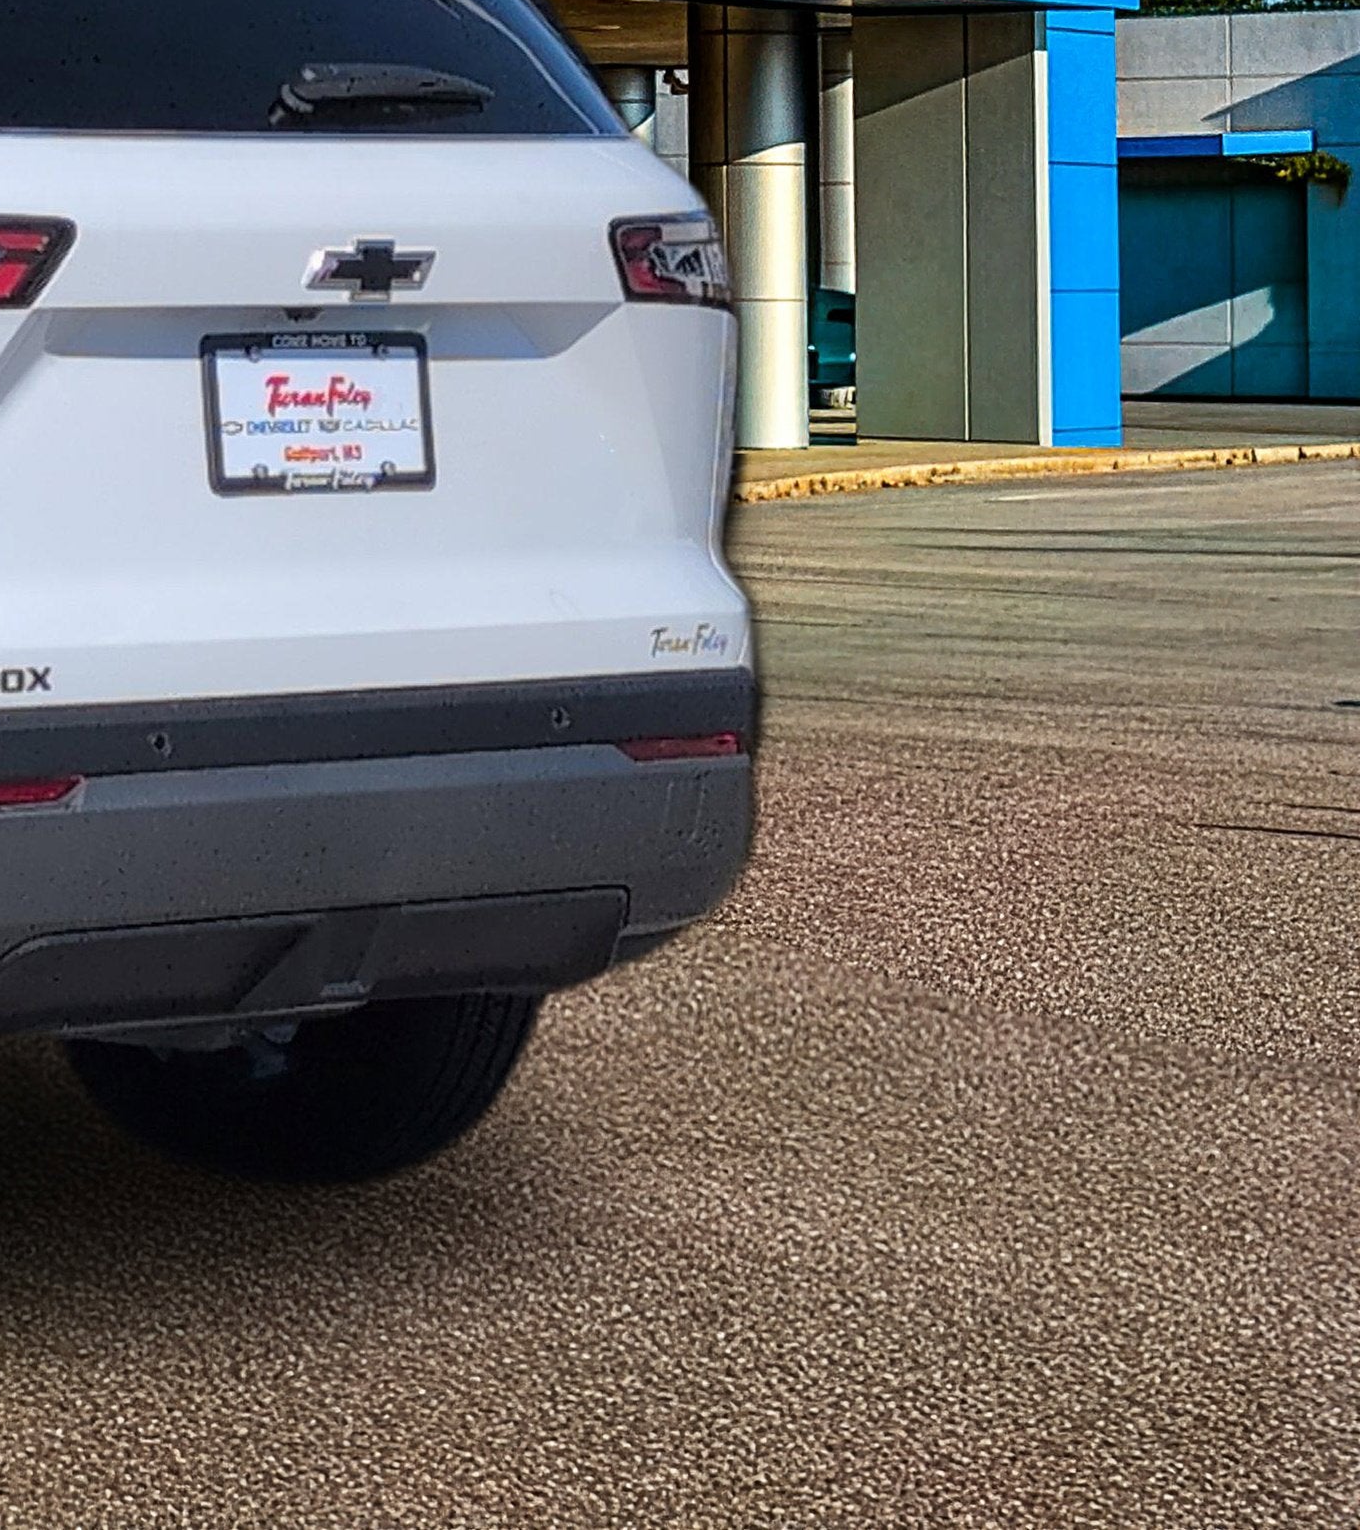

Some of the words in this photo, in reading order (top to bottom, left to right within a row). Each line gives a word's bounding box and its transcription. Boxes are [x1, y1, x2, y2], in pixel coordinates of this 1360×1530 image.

[265, 375, 326, 417] Turan
[326, 376, 372, 417] Foley
[342, 419, 418, 432] CADILLAC
